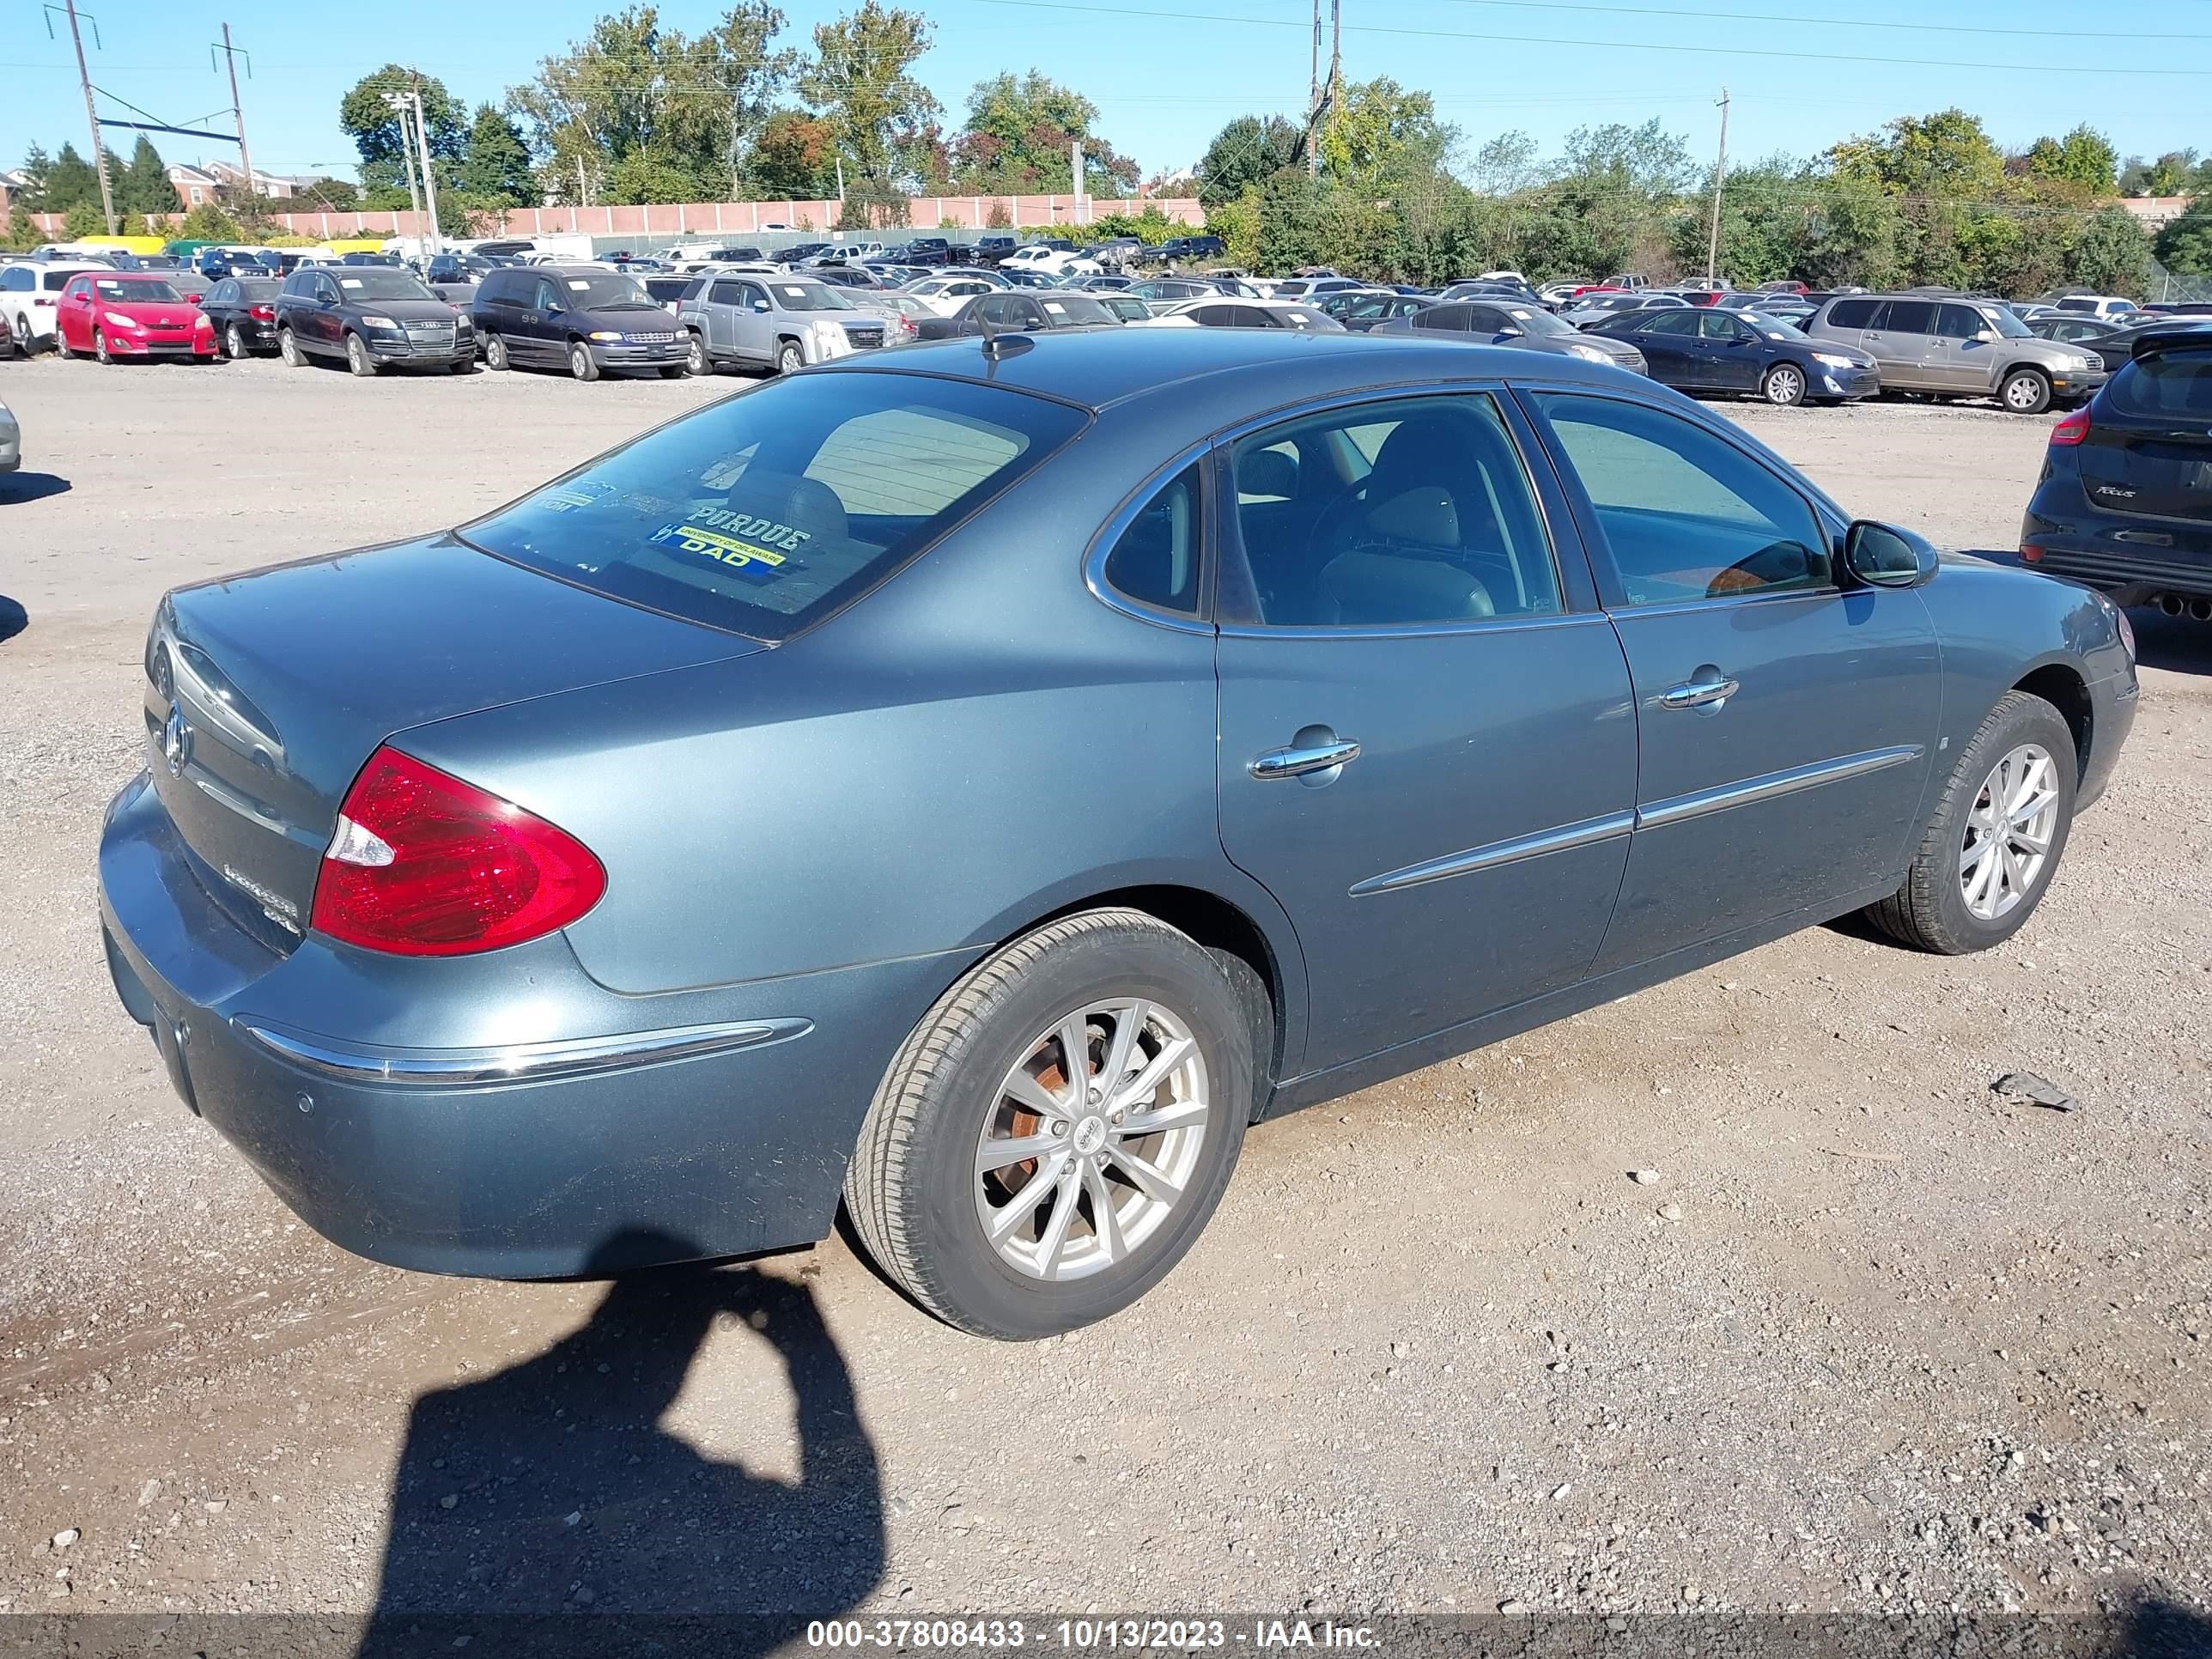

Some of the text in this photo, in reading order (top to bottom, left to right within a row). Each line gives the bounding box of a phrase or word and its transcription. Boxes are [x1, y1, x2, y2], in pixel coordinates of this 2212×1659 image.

[680, 527, 781, 562] UNIVERSITY OF DELAWARE
[686, 506, 811, 551] PURDUE
[679, 539, 750, 567] DAD
